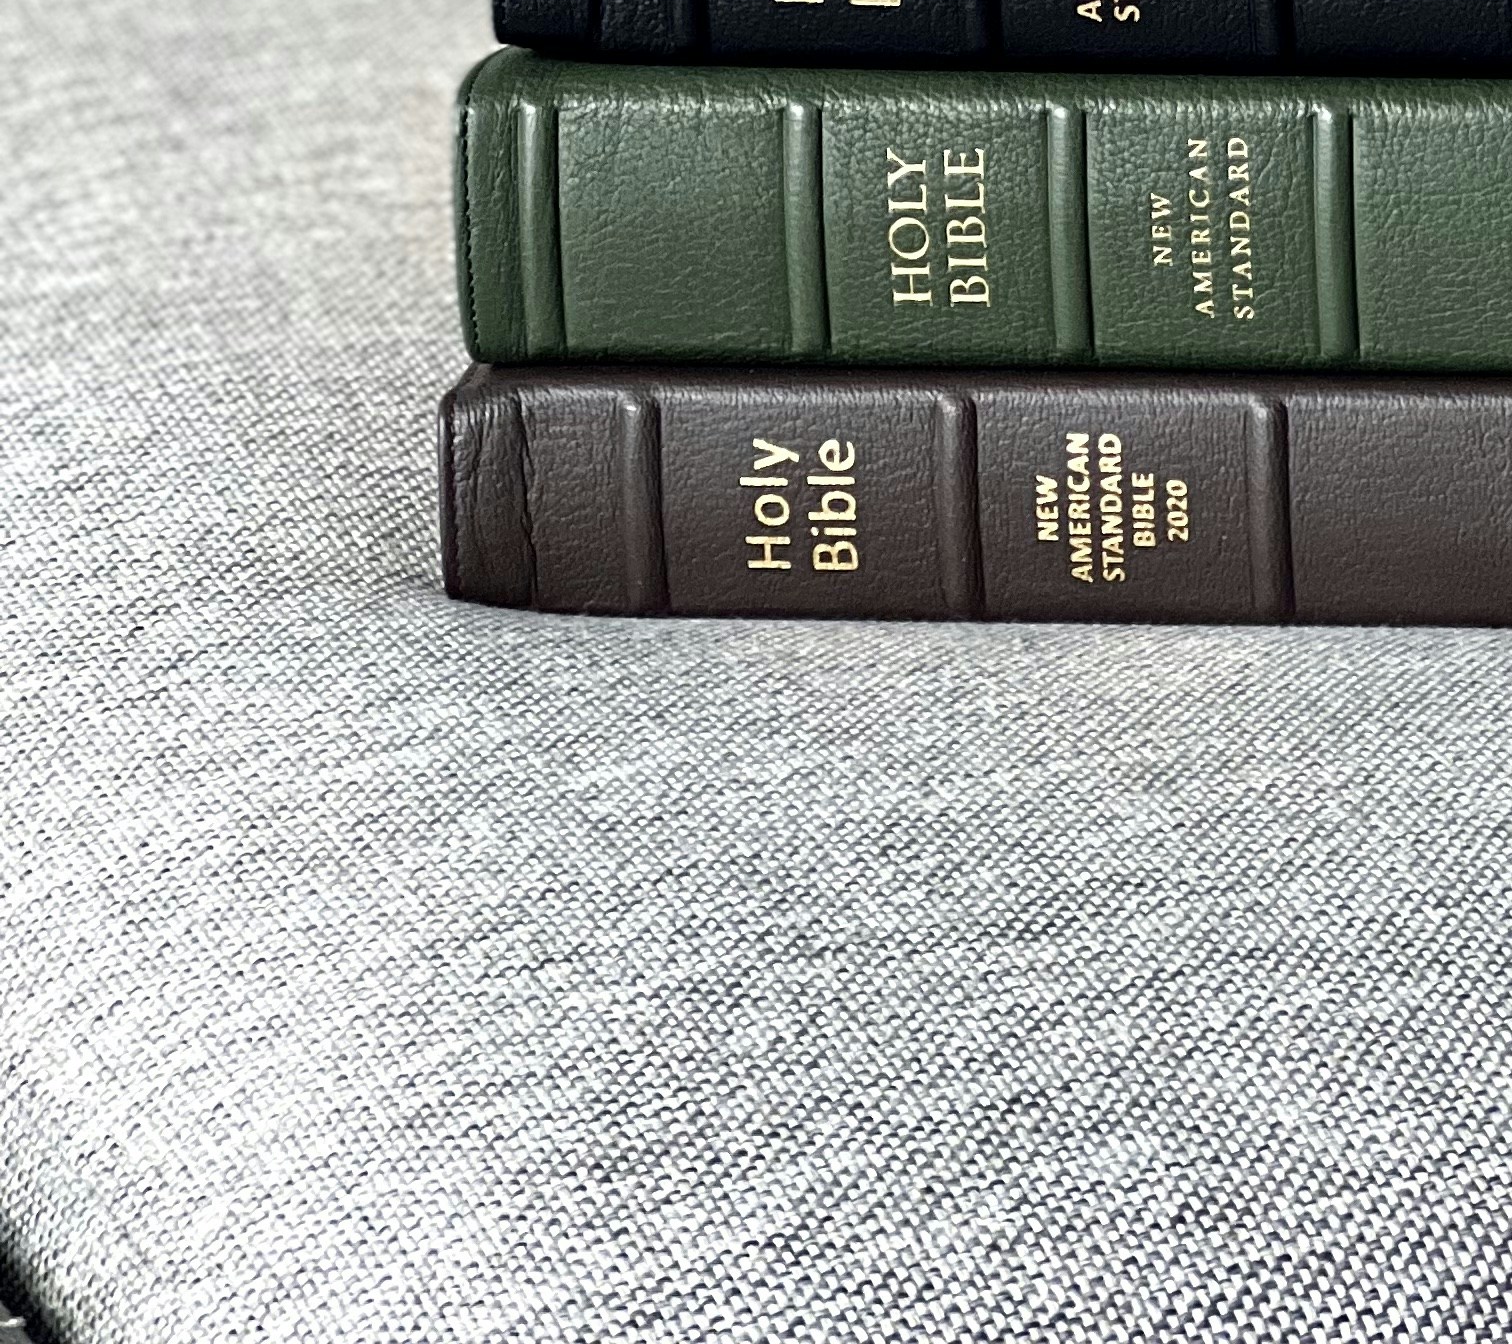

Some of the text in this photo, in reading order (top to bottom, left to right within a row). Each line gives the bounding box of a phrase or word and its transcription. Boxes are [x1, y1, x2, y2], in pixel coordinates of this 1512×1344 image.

[886, 147, 935, 306] HOLY
[943, 147, 991, 308] BIBLE
[1150, 192, 1174, 267] NEW
[1187, 136, 1215, 319] AMERICAN
[1227, 137, 1255, 320] STANDARD
[739, 437, 800, 570] Holy
[806, 438, 859, 571] Bible
[1035, 474, 1060, 541] NEW
[1065, 432, 1094, 583] AMERICAN
[1097, 432, 1126, 582] STANDARD
[1131, 472, 1156, 547] BIBLE
[1165, 479, 1189, 542] 2020
